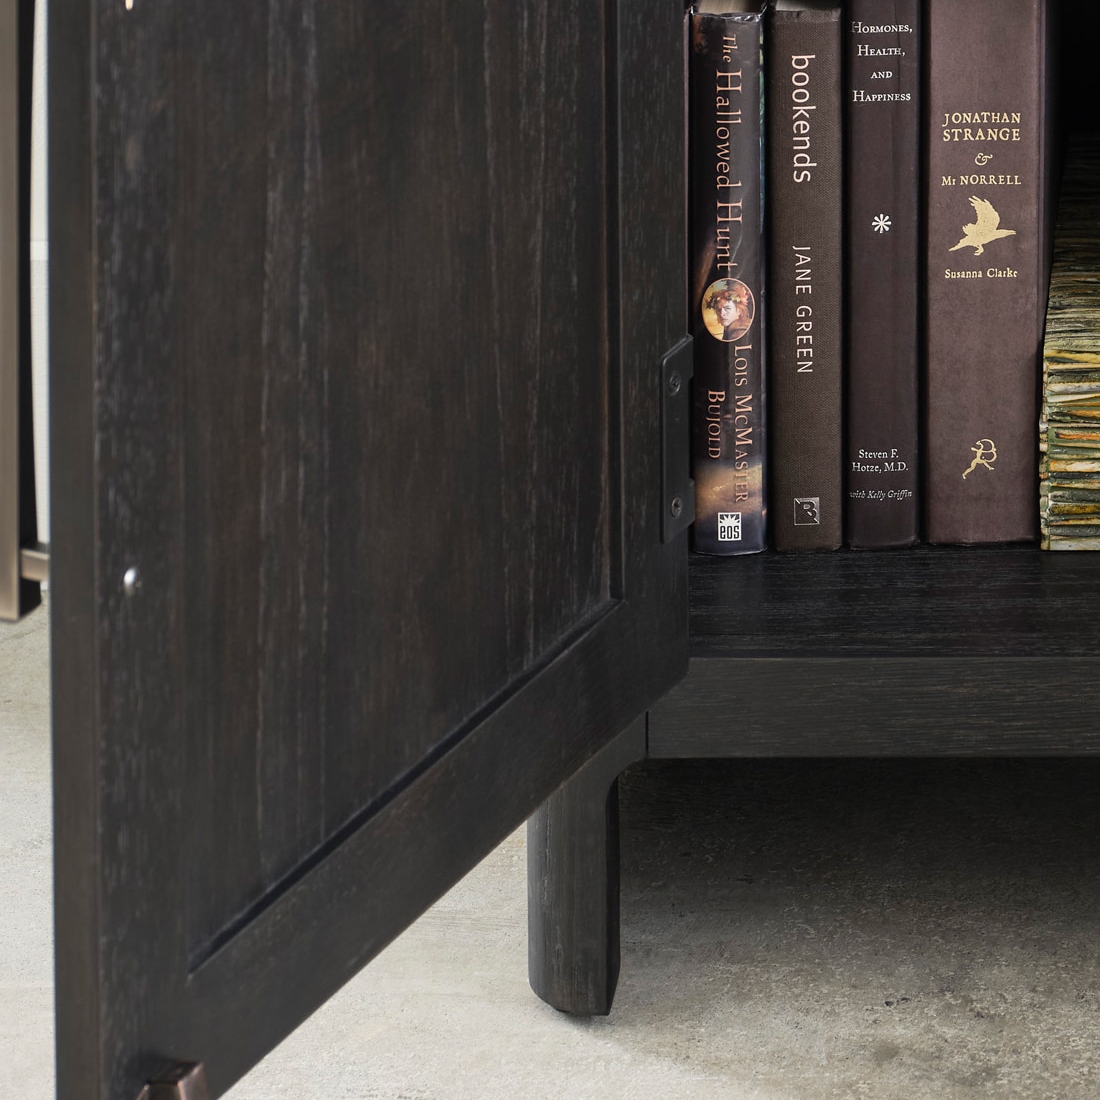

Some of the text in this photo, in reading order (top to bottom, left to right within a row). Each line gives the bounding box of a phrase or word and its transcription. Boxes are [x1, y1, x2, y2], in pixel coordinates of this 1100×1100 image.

[852, 21, 913, 34] HORMONES,
[857, 44, 906, 57] HEALTH,
[870, 71, 893, 79] AND
[853, 90, 912, 102] HAPPINESS
[791, 55, 817, 183] bookends
[942, 112, 1021, 126] JONATHAN
[943, 128, 1021, 142] STRANGE
[716, 34, 743, 270] The Hallowed Hunt
[975, 152, 993, 166] &
[941, 174, 1021, 187] Mr NORRELL
[944, 267, 1018, 279] Susanna Clarke
[792, 246, 813, 373] JANE GREEN
[734, 344, 753, 388] LOIS
[706, 390, 726, 460] BUJOLD
[858, 448, 899, 459] Steven F.
[851, 461, 909, 474] Hotze, M.D.
[867, 490, 886, 501] Kelly
[887, 489, 912, 500] Griffin
[719, 524, 740, 540] eos
